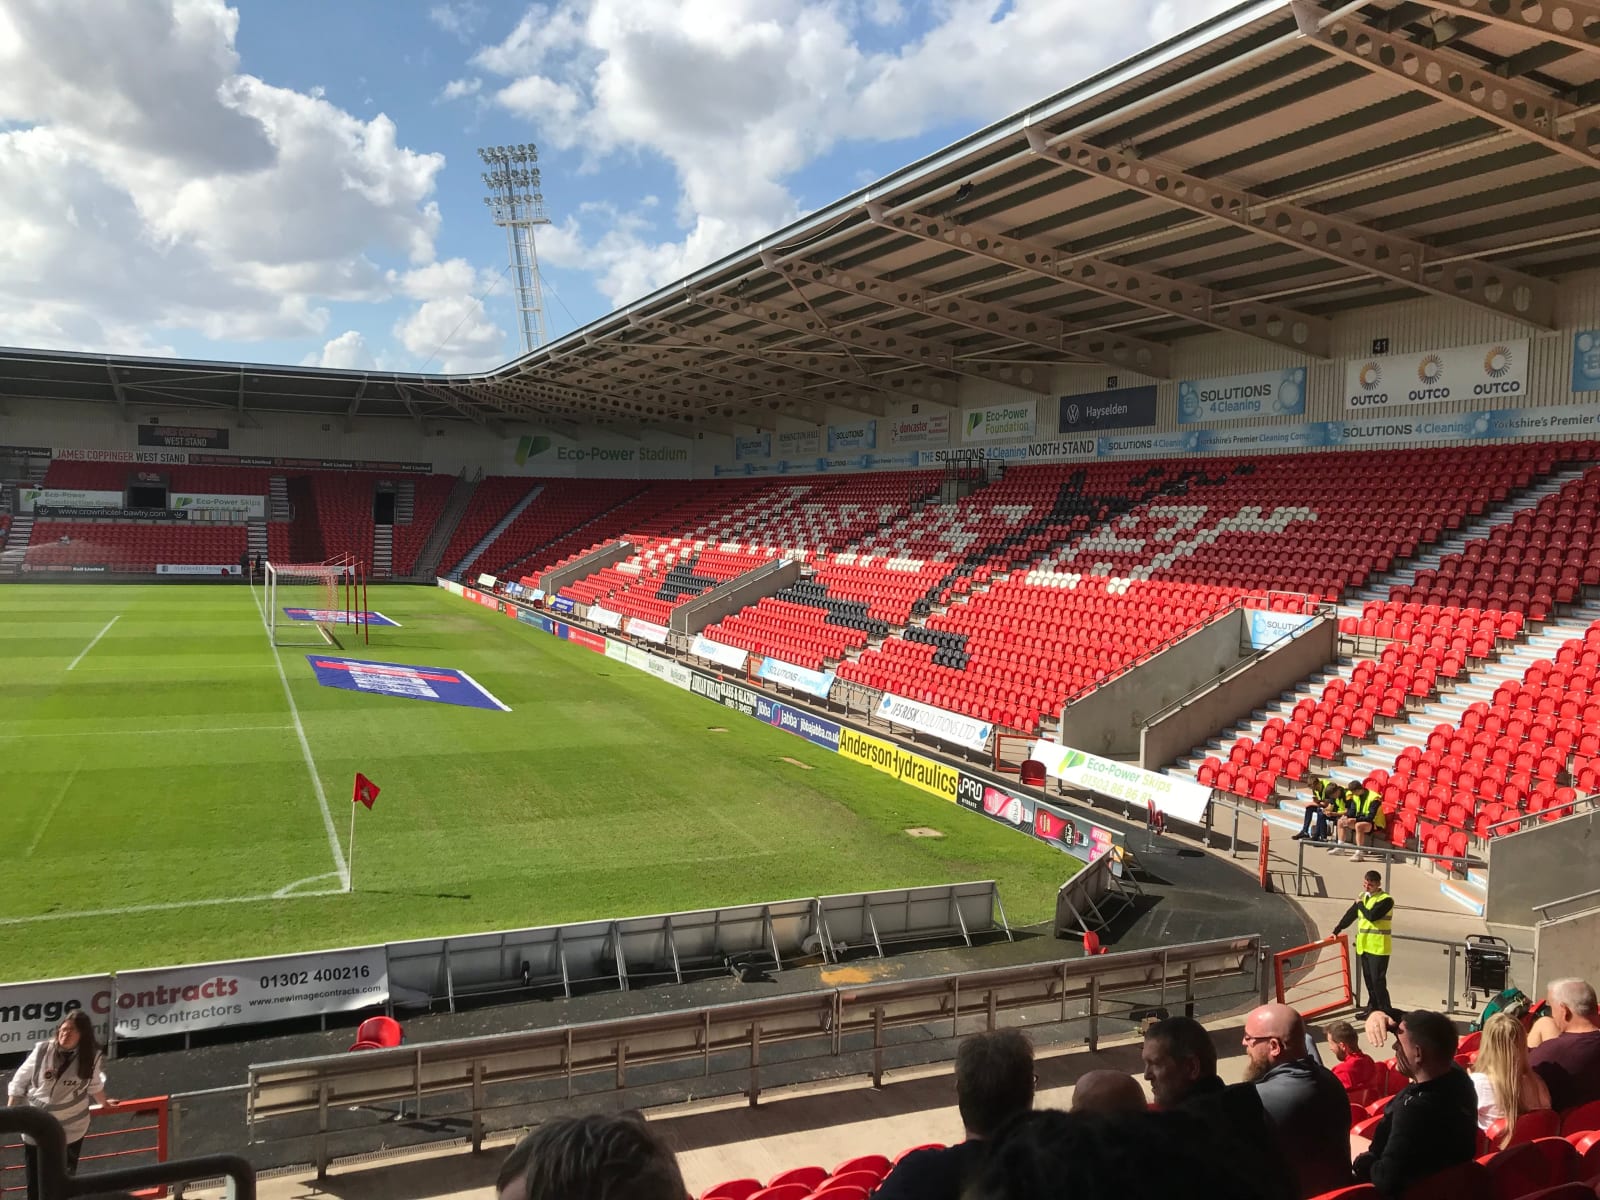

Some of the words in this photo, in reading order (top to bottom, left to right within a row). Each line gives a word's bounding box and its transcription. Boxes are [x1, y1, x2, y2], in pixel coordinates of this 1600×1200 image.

[1374, 340, 1386, 352] 41
[1200, 384, 1272, 402] SOLUTIONS
[1408, 388, 1450, 400] OUTCO
[1474, 380, 1520, 395] OUTCO
[1351, 394, 1388, 406] OUTCO
[986, 408, 1028, 422] Eco-Power
[1086, 403, 1128, 419] Hayselden
[1550, 414, 1594, 426] Premier
[900, 422, 928, 433] doncaster
[986, 422, 1028, 434] Foundation
[1342, 424, 1413, 438] SOLUTIONS
[164, 437, 184, 446] WEST
[185, 438, 207, 448] STAND
[1108, 440, 1152, 450] SOLUTIONS
[1233, 434, 1258, 444] Premier
[1259, 432, 1289, 444] Cleaning
[57, 450, 85, 460] JAMES
[88, 450, 134, 461] COPPINGER
[136, 452, 158, 462] WEST
[161, 453, 186, 463] STAND
[558, 446, 633, 460] Eco-Power
[638, 446, 687, 461] Stadium
[921, 451, 934, 462] THE
[935, 448, 985, 462] SOLUTIONS
[1028, 442, 1060, 456] NORTH
[1062, 440, 1094, 454] STAND
[768, 665, 798, 681] SOLUTIONS
[902, 706, 920, 721] RISK
[916, 709, 960, 736] SOLUTIONS
[959, 722, 976, 740] LTD
[840, 730, 892, 769] Anderson
[1087, 758, 1140, 783] Eco-Power
[1142, 774, 1172, 792] Skips
[260, 971, 308, 990] 01302
[313, 965, 370, 983] 400216
[145, 1002, 242, 1026] Contractors
